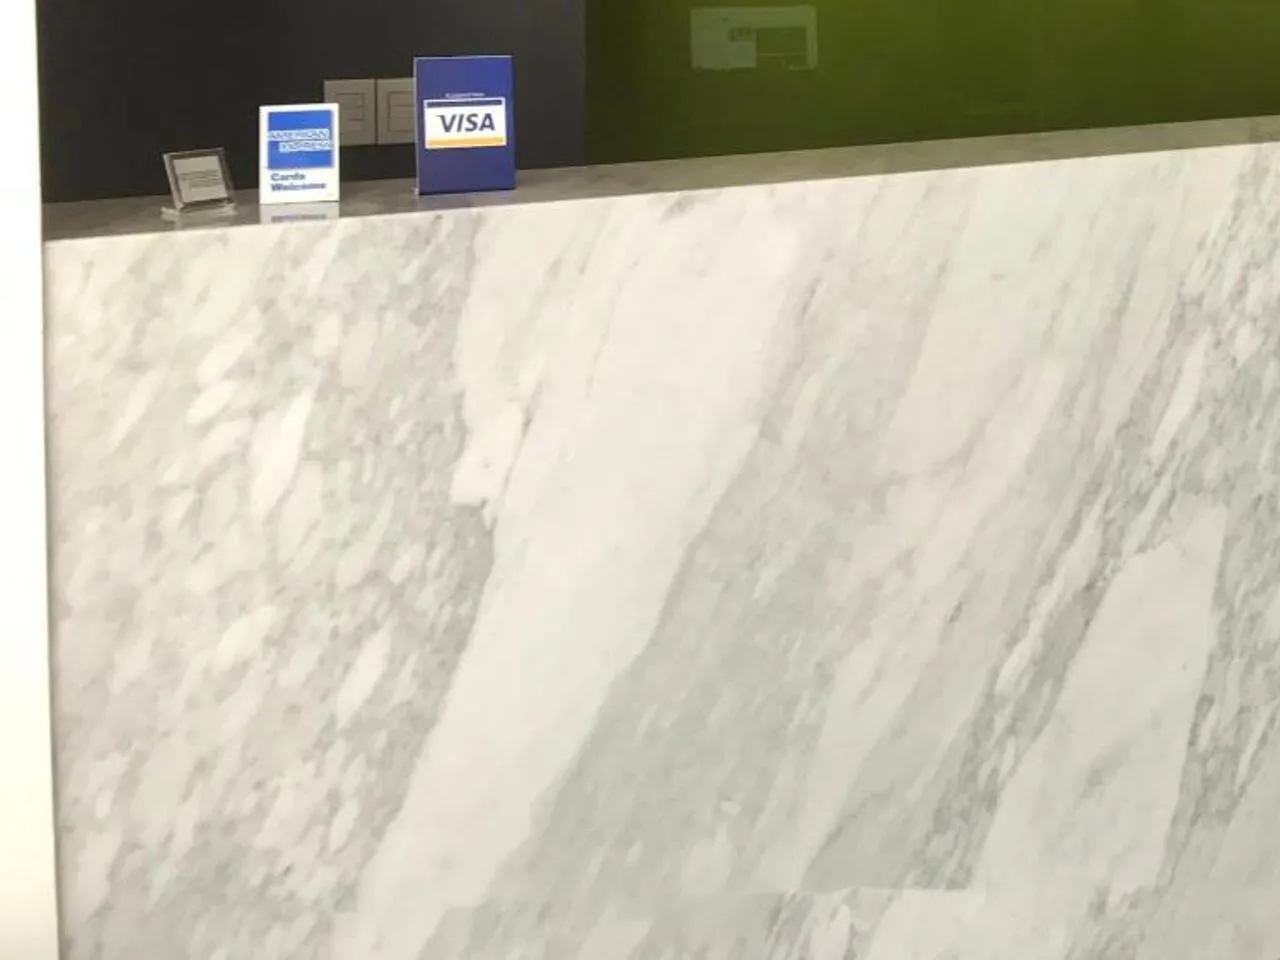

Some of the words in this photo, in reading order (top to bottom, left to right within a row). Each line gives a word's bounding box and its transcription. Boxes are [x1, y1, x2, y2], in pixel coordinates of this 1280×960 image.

[436, 112, 496, 133] VISA
[270, 171, 306, 182] Cards
[270, 182, 327, 192] Welcome
